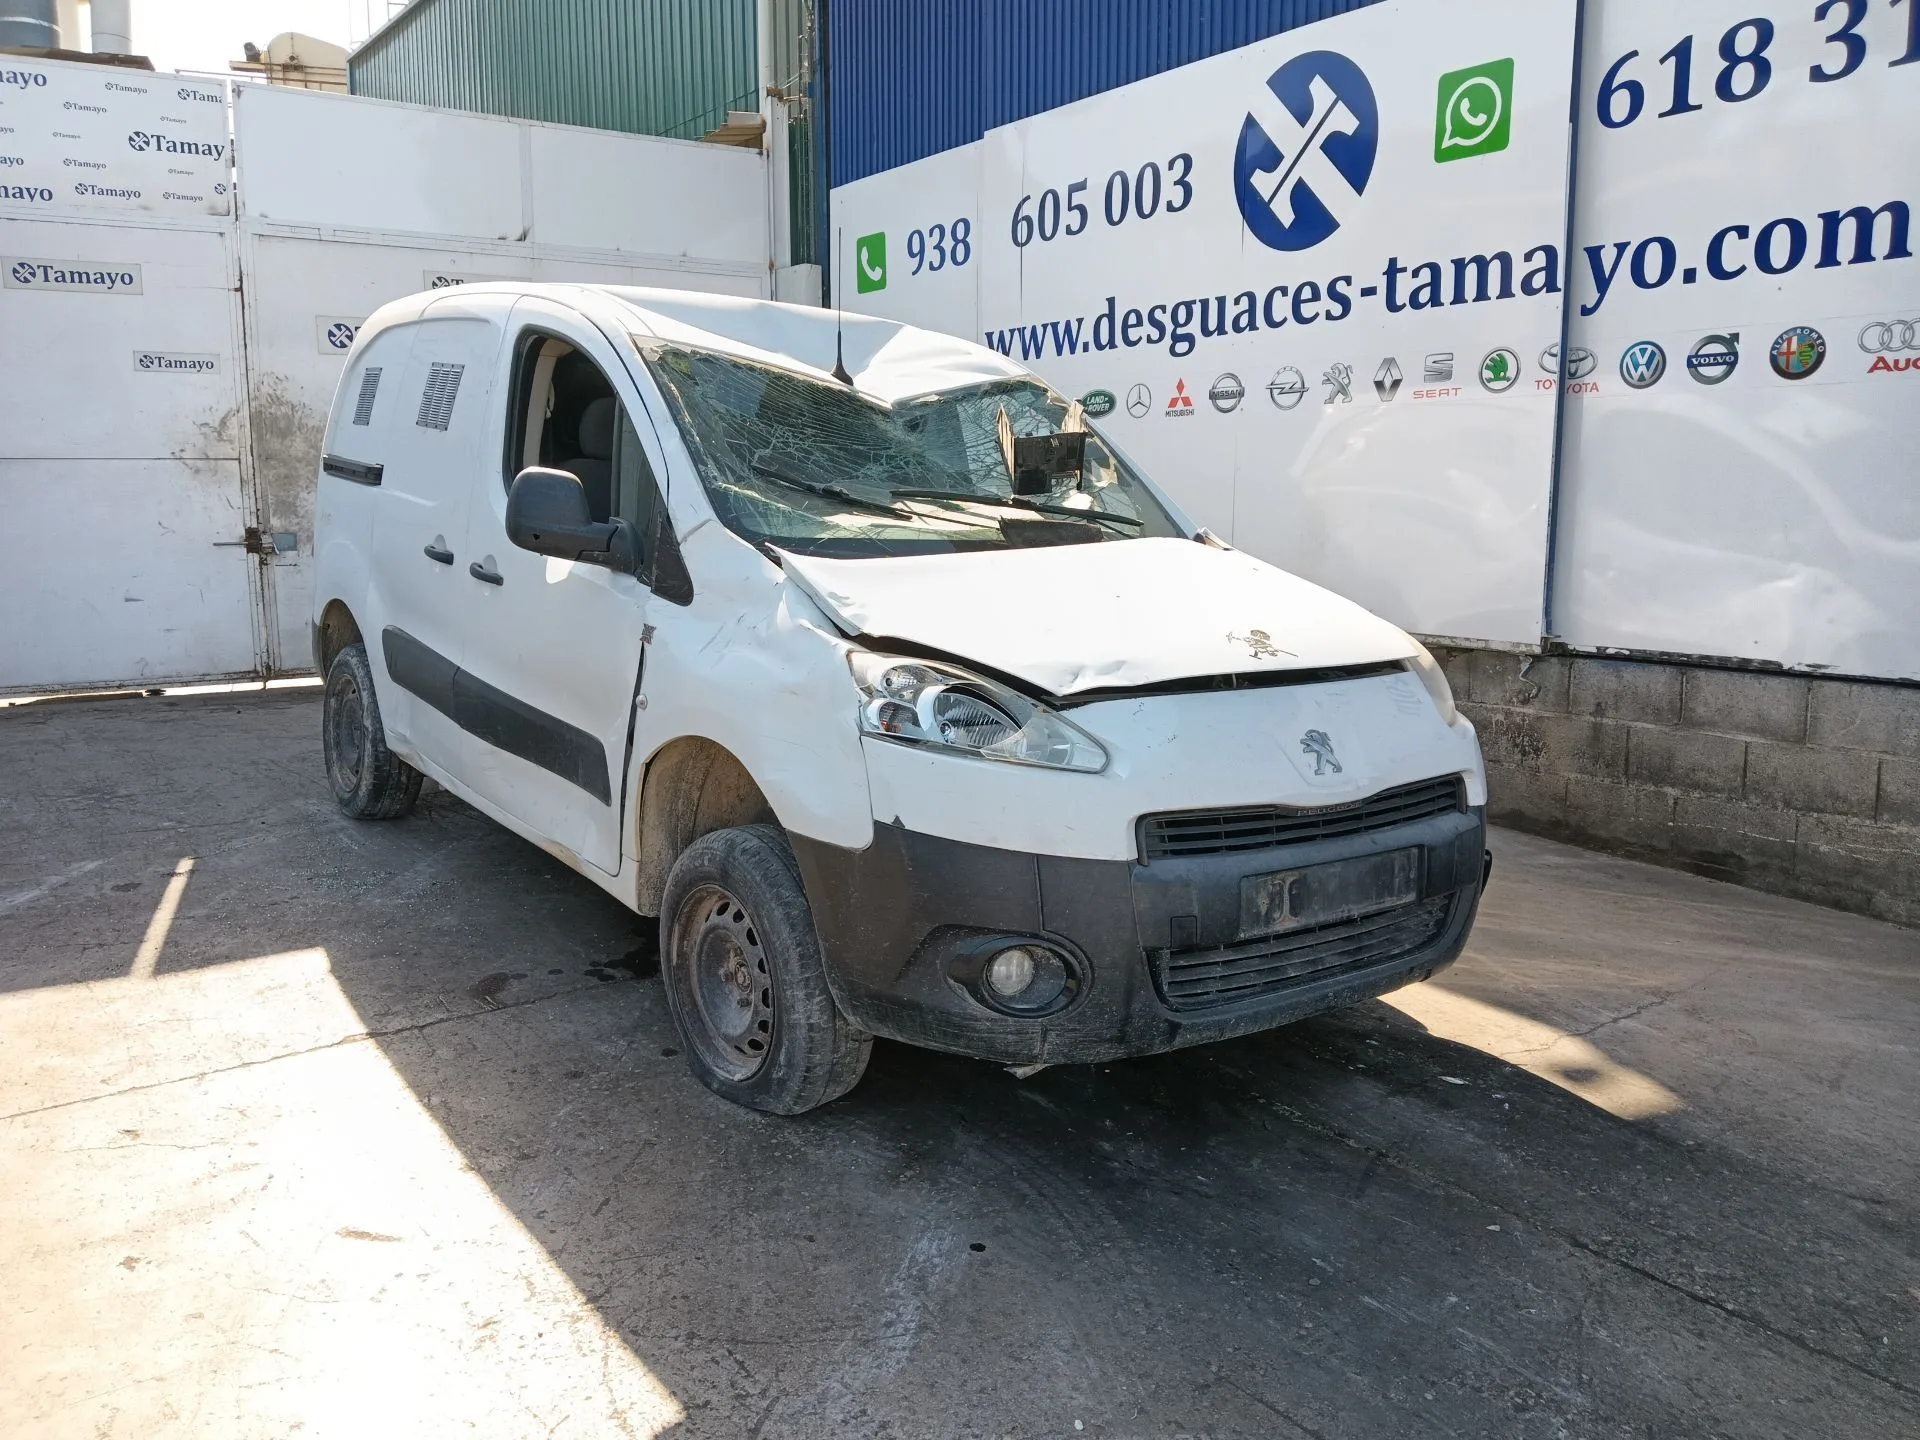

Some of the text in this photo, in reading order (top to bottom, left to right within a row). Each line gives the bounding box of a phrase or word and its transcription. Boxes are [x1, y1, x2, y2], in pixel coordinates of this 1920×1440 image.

[1596, 17, 1774, 129] 618
[0, 70, 48, 90] ayo
[113, 83, 148, 95] Tamayo
[72, 102, 107, 114] Tamayo
[165, 116, 187, 124] Tamayo
[151, 134, 225, 161] Tamay
[72, 158, 107, 170] Tamayo
[88, 184, 141, 200] Tamayo
[170, 192, 204, 202] Tamayo
[906, 152, 1193, 276] 938 605 003
[37, 264, 134, 290] Tamayo
[1771, 328, 1825, 356] ALFA ROMEO
[155, 356, 214, 373] Tamayo
[1691, 355, 1735, 365] VOLVO
[1213, 388, 1241, 398] NISSAN
[1413, 387, 1462, 399] SEAT
[1165, 408, 1195, 418] MITSUBISHI
